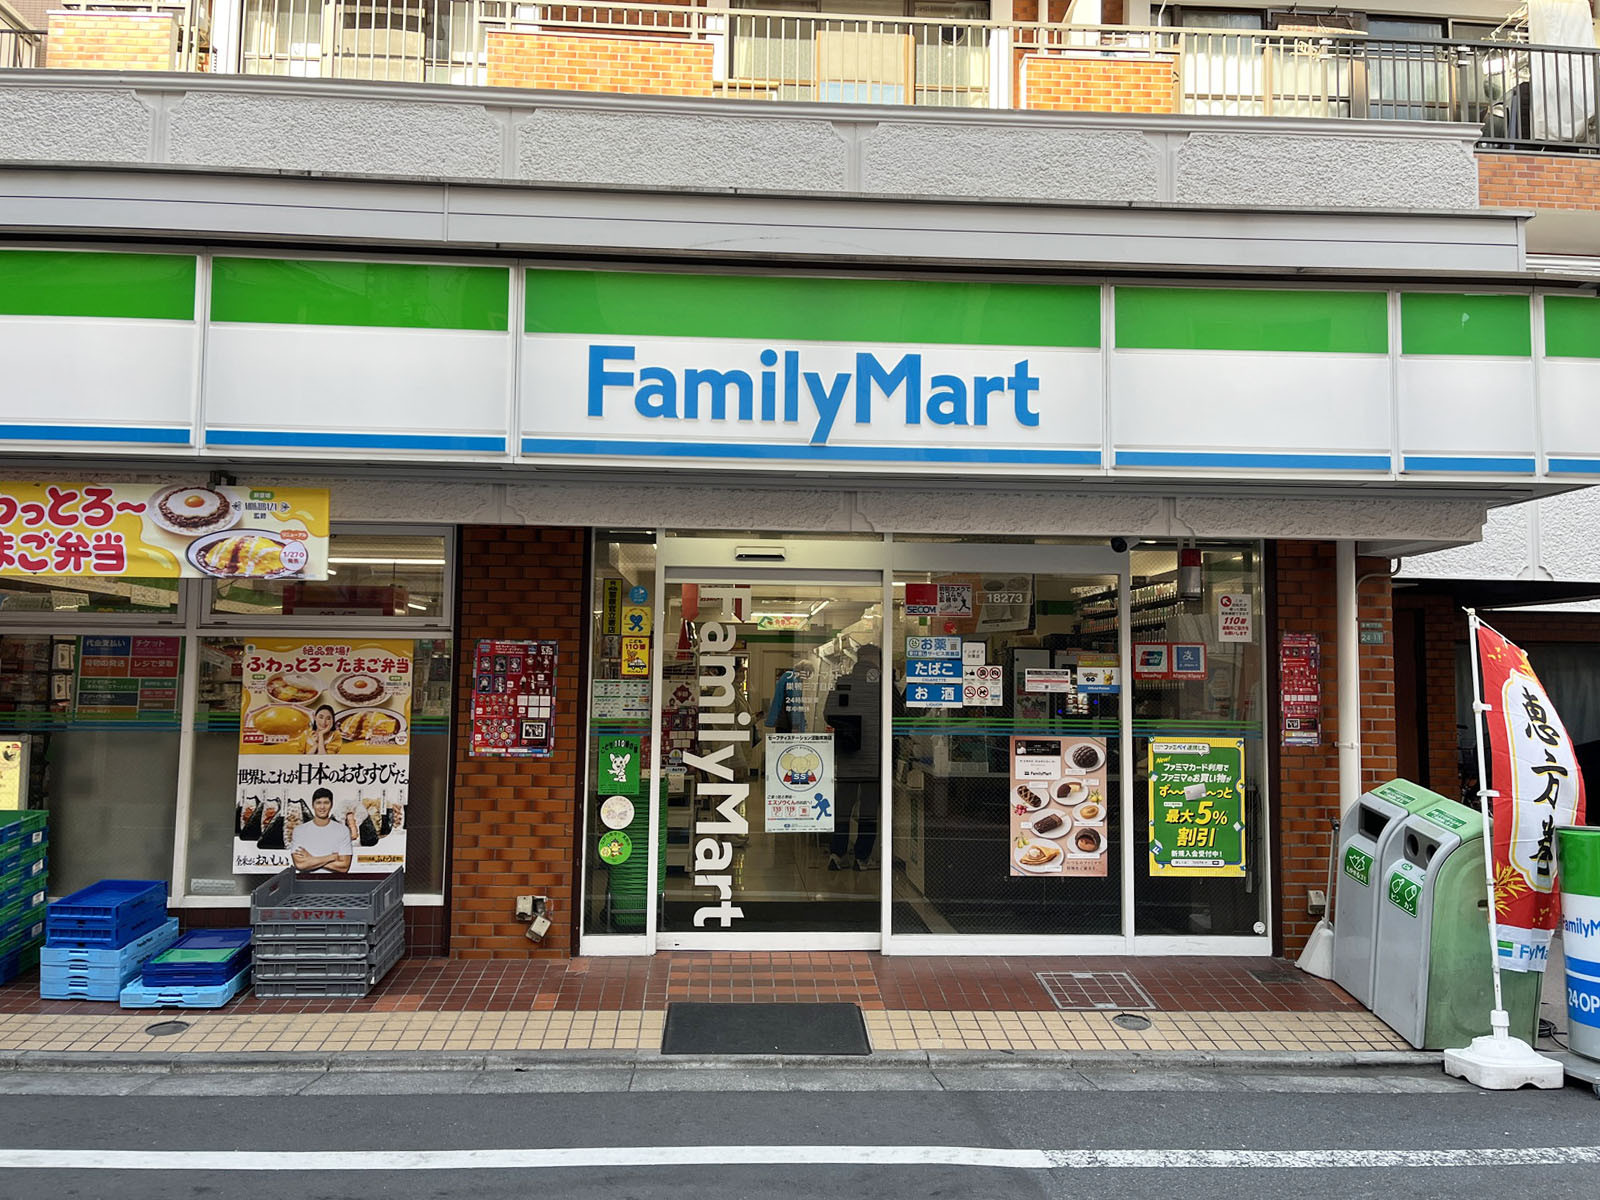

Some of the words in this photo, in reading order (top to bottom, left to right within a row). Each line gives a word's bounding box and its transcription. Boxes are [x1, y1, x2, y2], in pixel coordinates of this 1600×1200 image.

[587, 345, 1040, 447] FamilyMart
[986, 593, 1023, 603] 18273
[906, 605, 937, 614] SECOM
[921, 638, 947, 651] お薬
[914, 662, 955, 676] たばこ
[683, 586, 751, 927] FamilyMart
[1156, 755, 1172, 764] New!
[1163, 763, 1230, 772] ファミマカード利用で
[1160, 773, 1232, 784] ファミマのお買い物が
[1176, 826, 1216, 848] 割引
